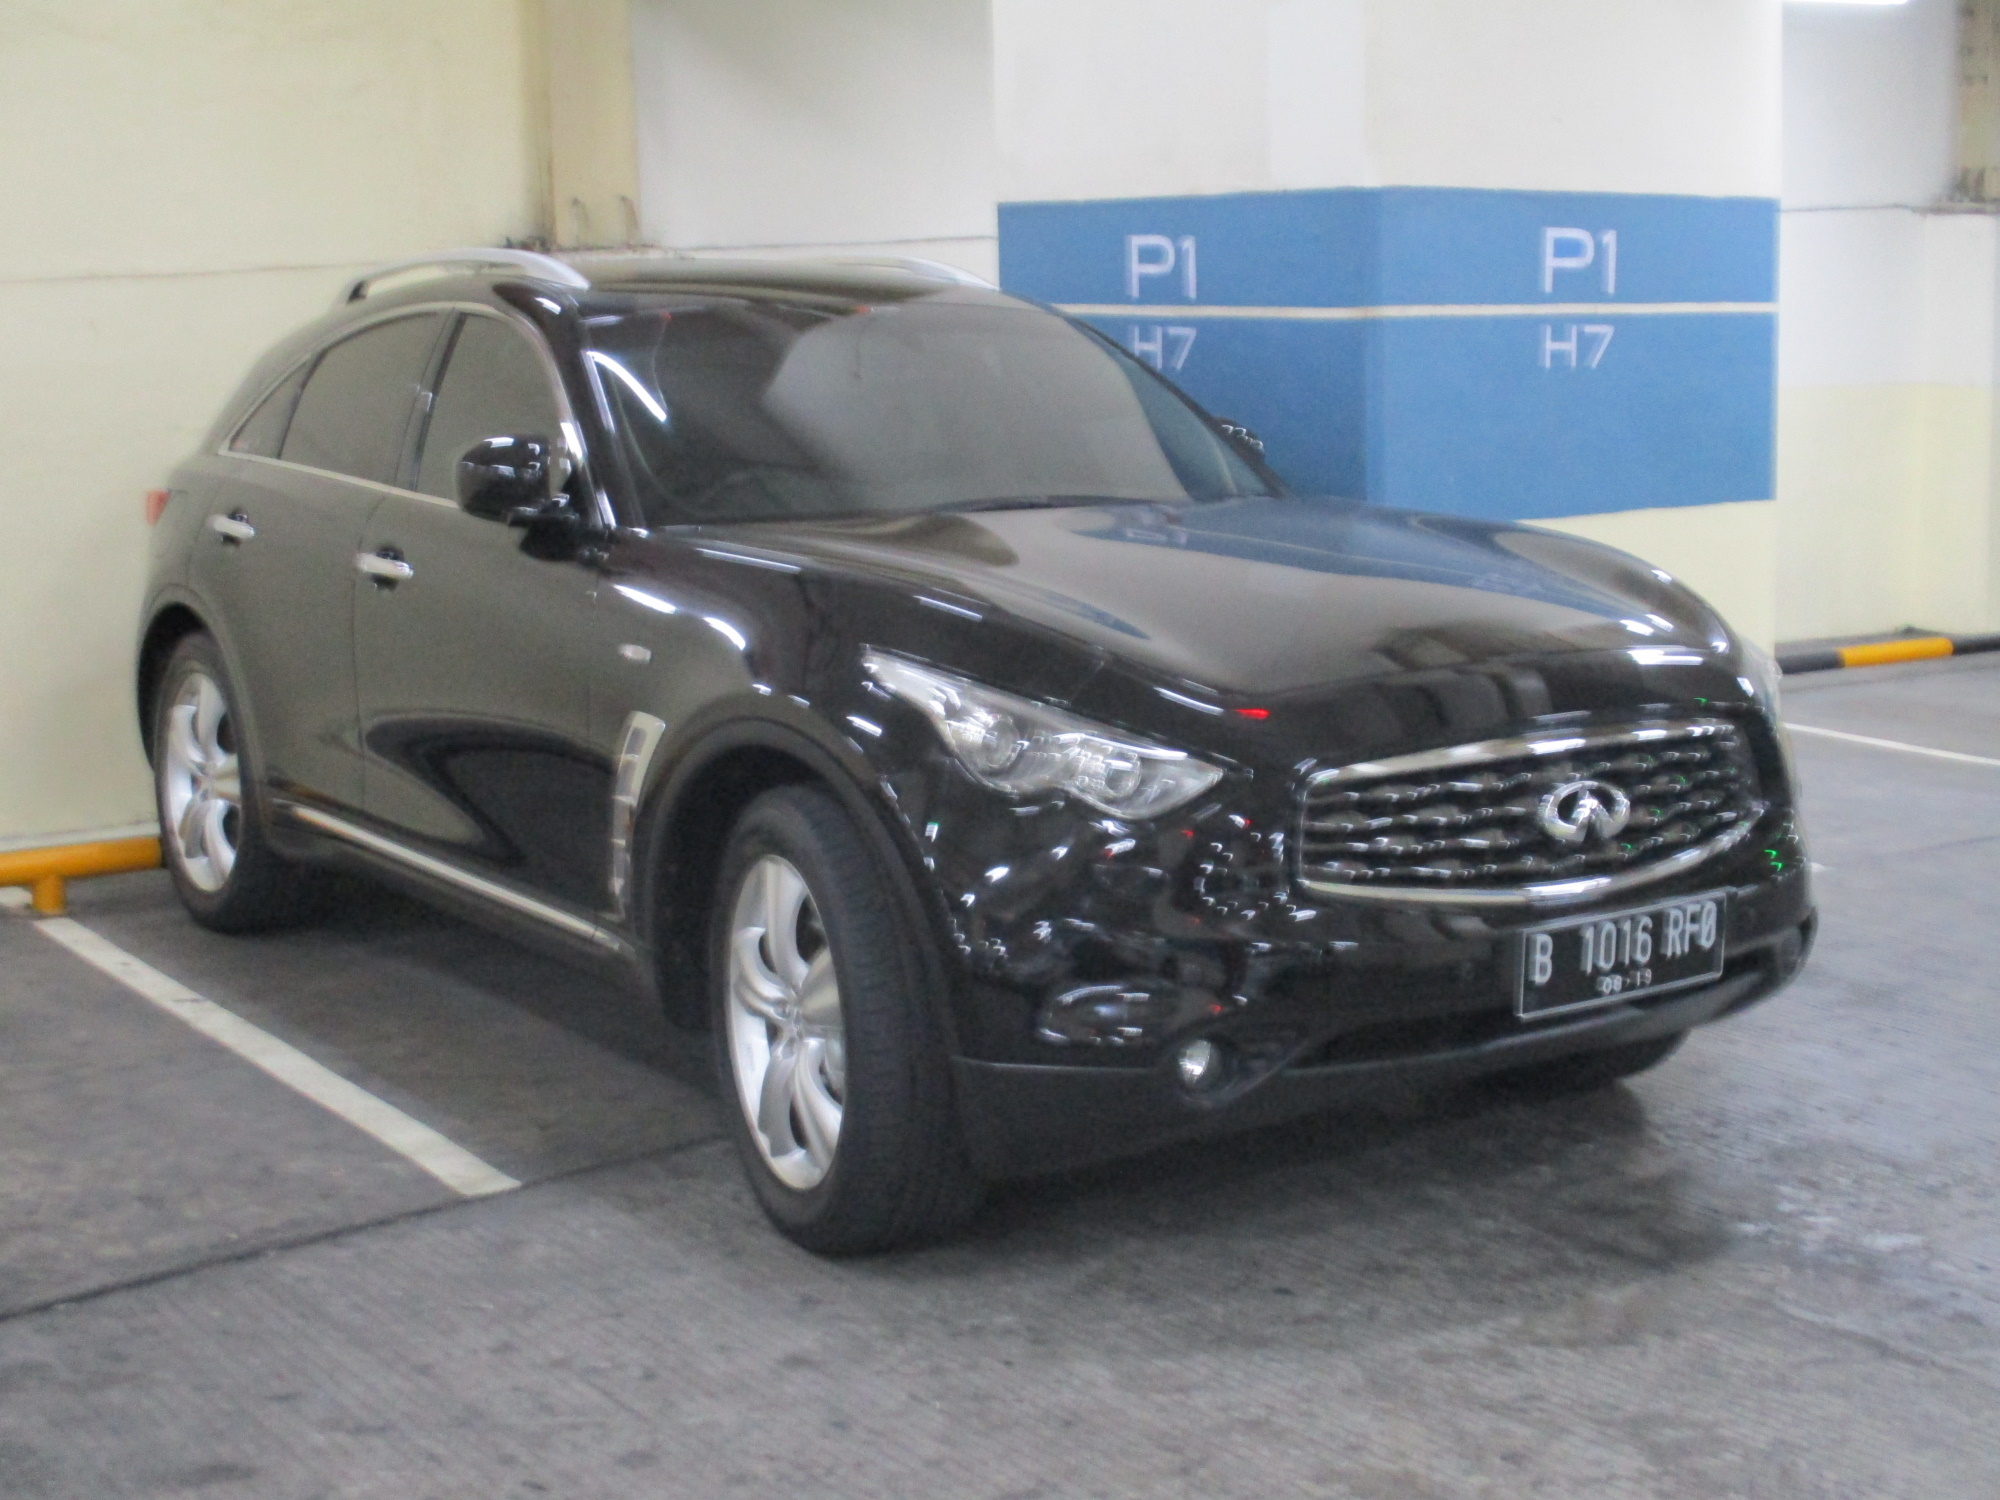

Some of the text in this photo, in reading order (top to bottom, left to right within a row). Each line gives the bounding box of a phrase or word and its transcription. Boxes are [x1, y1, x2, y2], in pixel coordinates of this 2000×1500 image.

[1128, 234, 1197, 300] P1
[1542, 227, 1617, 296] P1
[1132, 325, 1197, 372] H7
[1543, 324, 1616, 370] H7
[1530, 933, 1554, 986] B
[1581, 915, 1653, 976] 1016
